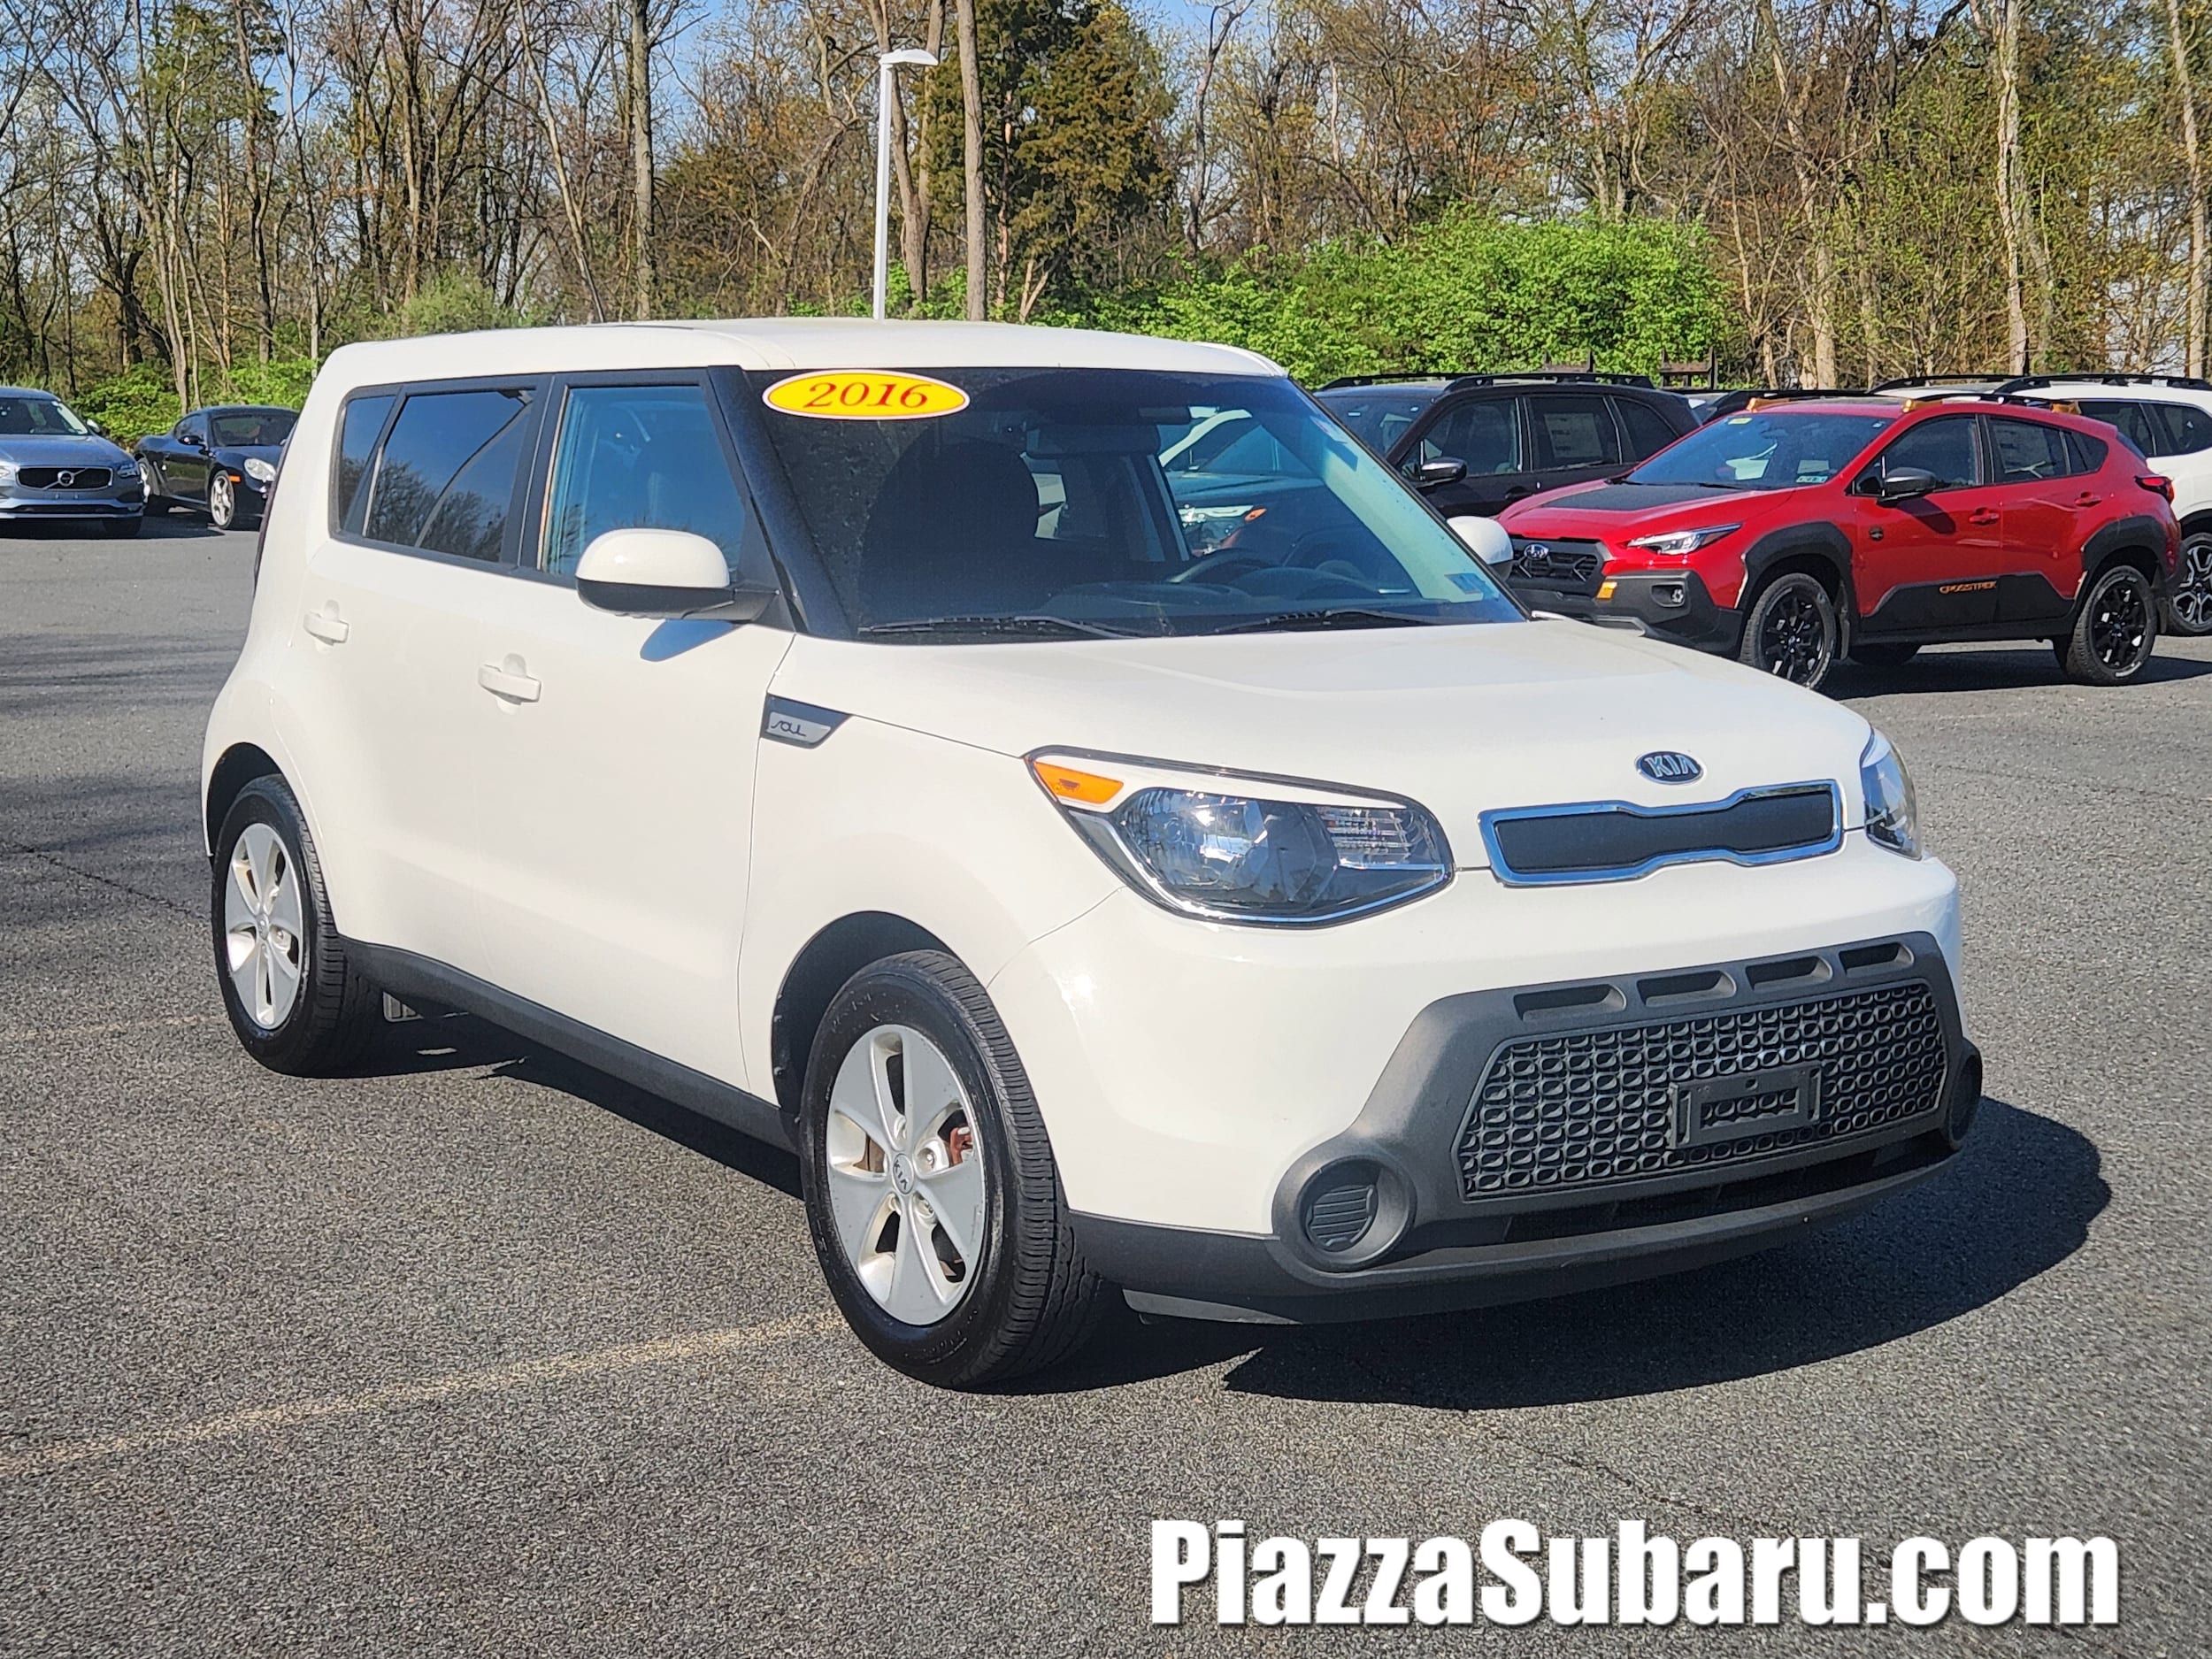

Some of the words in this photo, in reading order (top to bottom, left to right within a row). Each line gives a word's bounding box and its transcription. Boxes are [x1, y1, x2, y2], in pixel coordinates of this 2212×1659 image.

[803, 381, 932, 409] 2016
[1643, 754, 1700, 778] KIA
[893, 1158, 908, 1191] KIA
